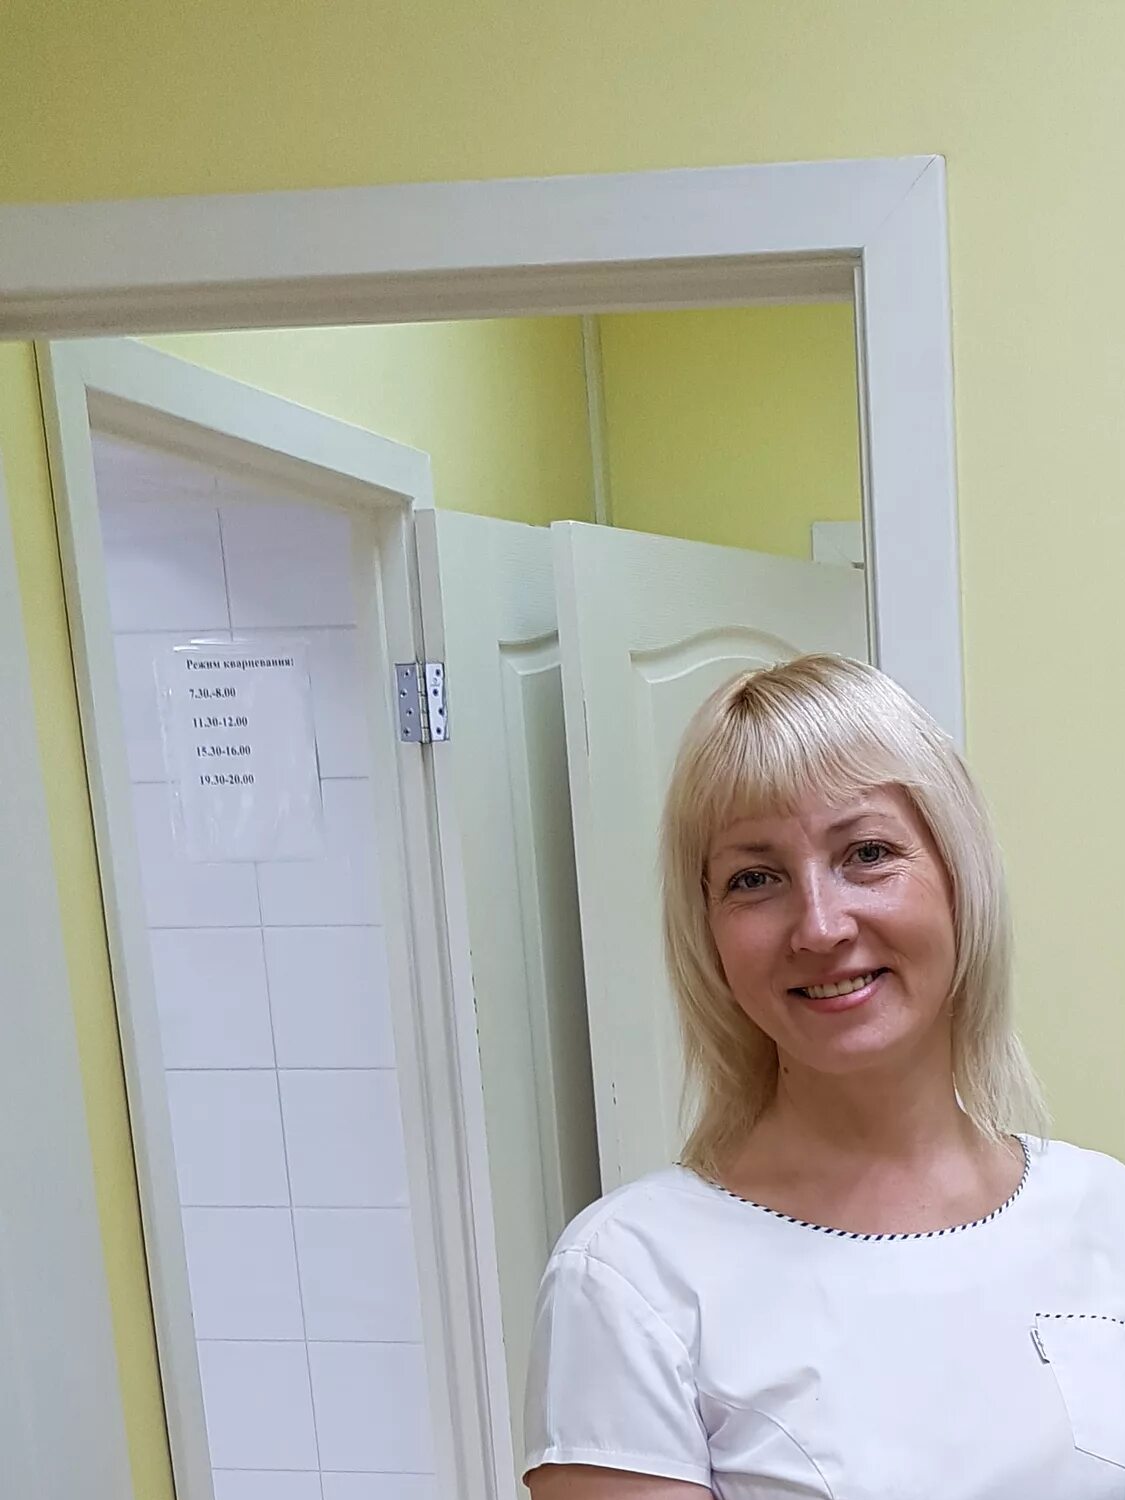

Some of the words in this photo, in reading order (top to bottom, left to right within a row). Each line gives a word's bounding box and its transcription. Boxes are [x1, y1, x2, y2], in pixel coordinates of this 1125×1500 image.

[186, 659, 220, 670] Режим
[189, 687, 236, 699] 7.30.-8.00
[193, 717, 249, 729] 11.30-12.00
[196, 745, 251, 757] 15.30-16.00
[199, 774, 254, 786] 19.30-20.00
